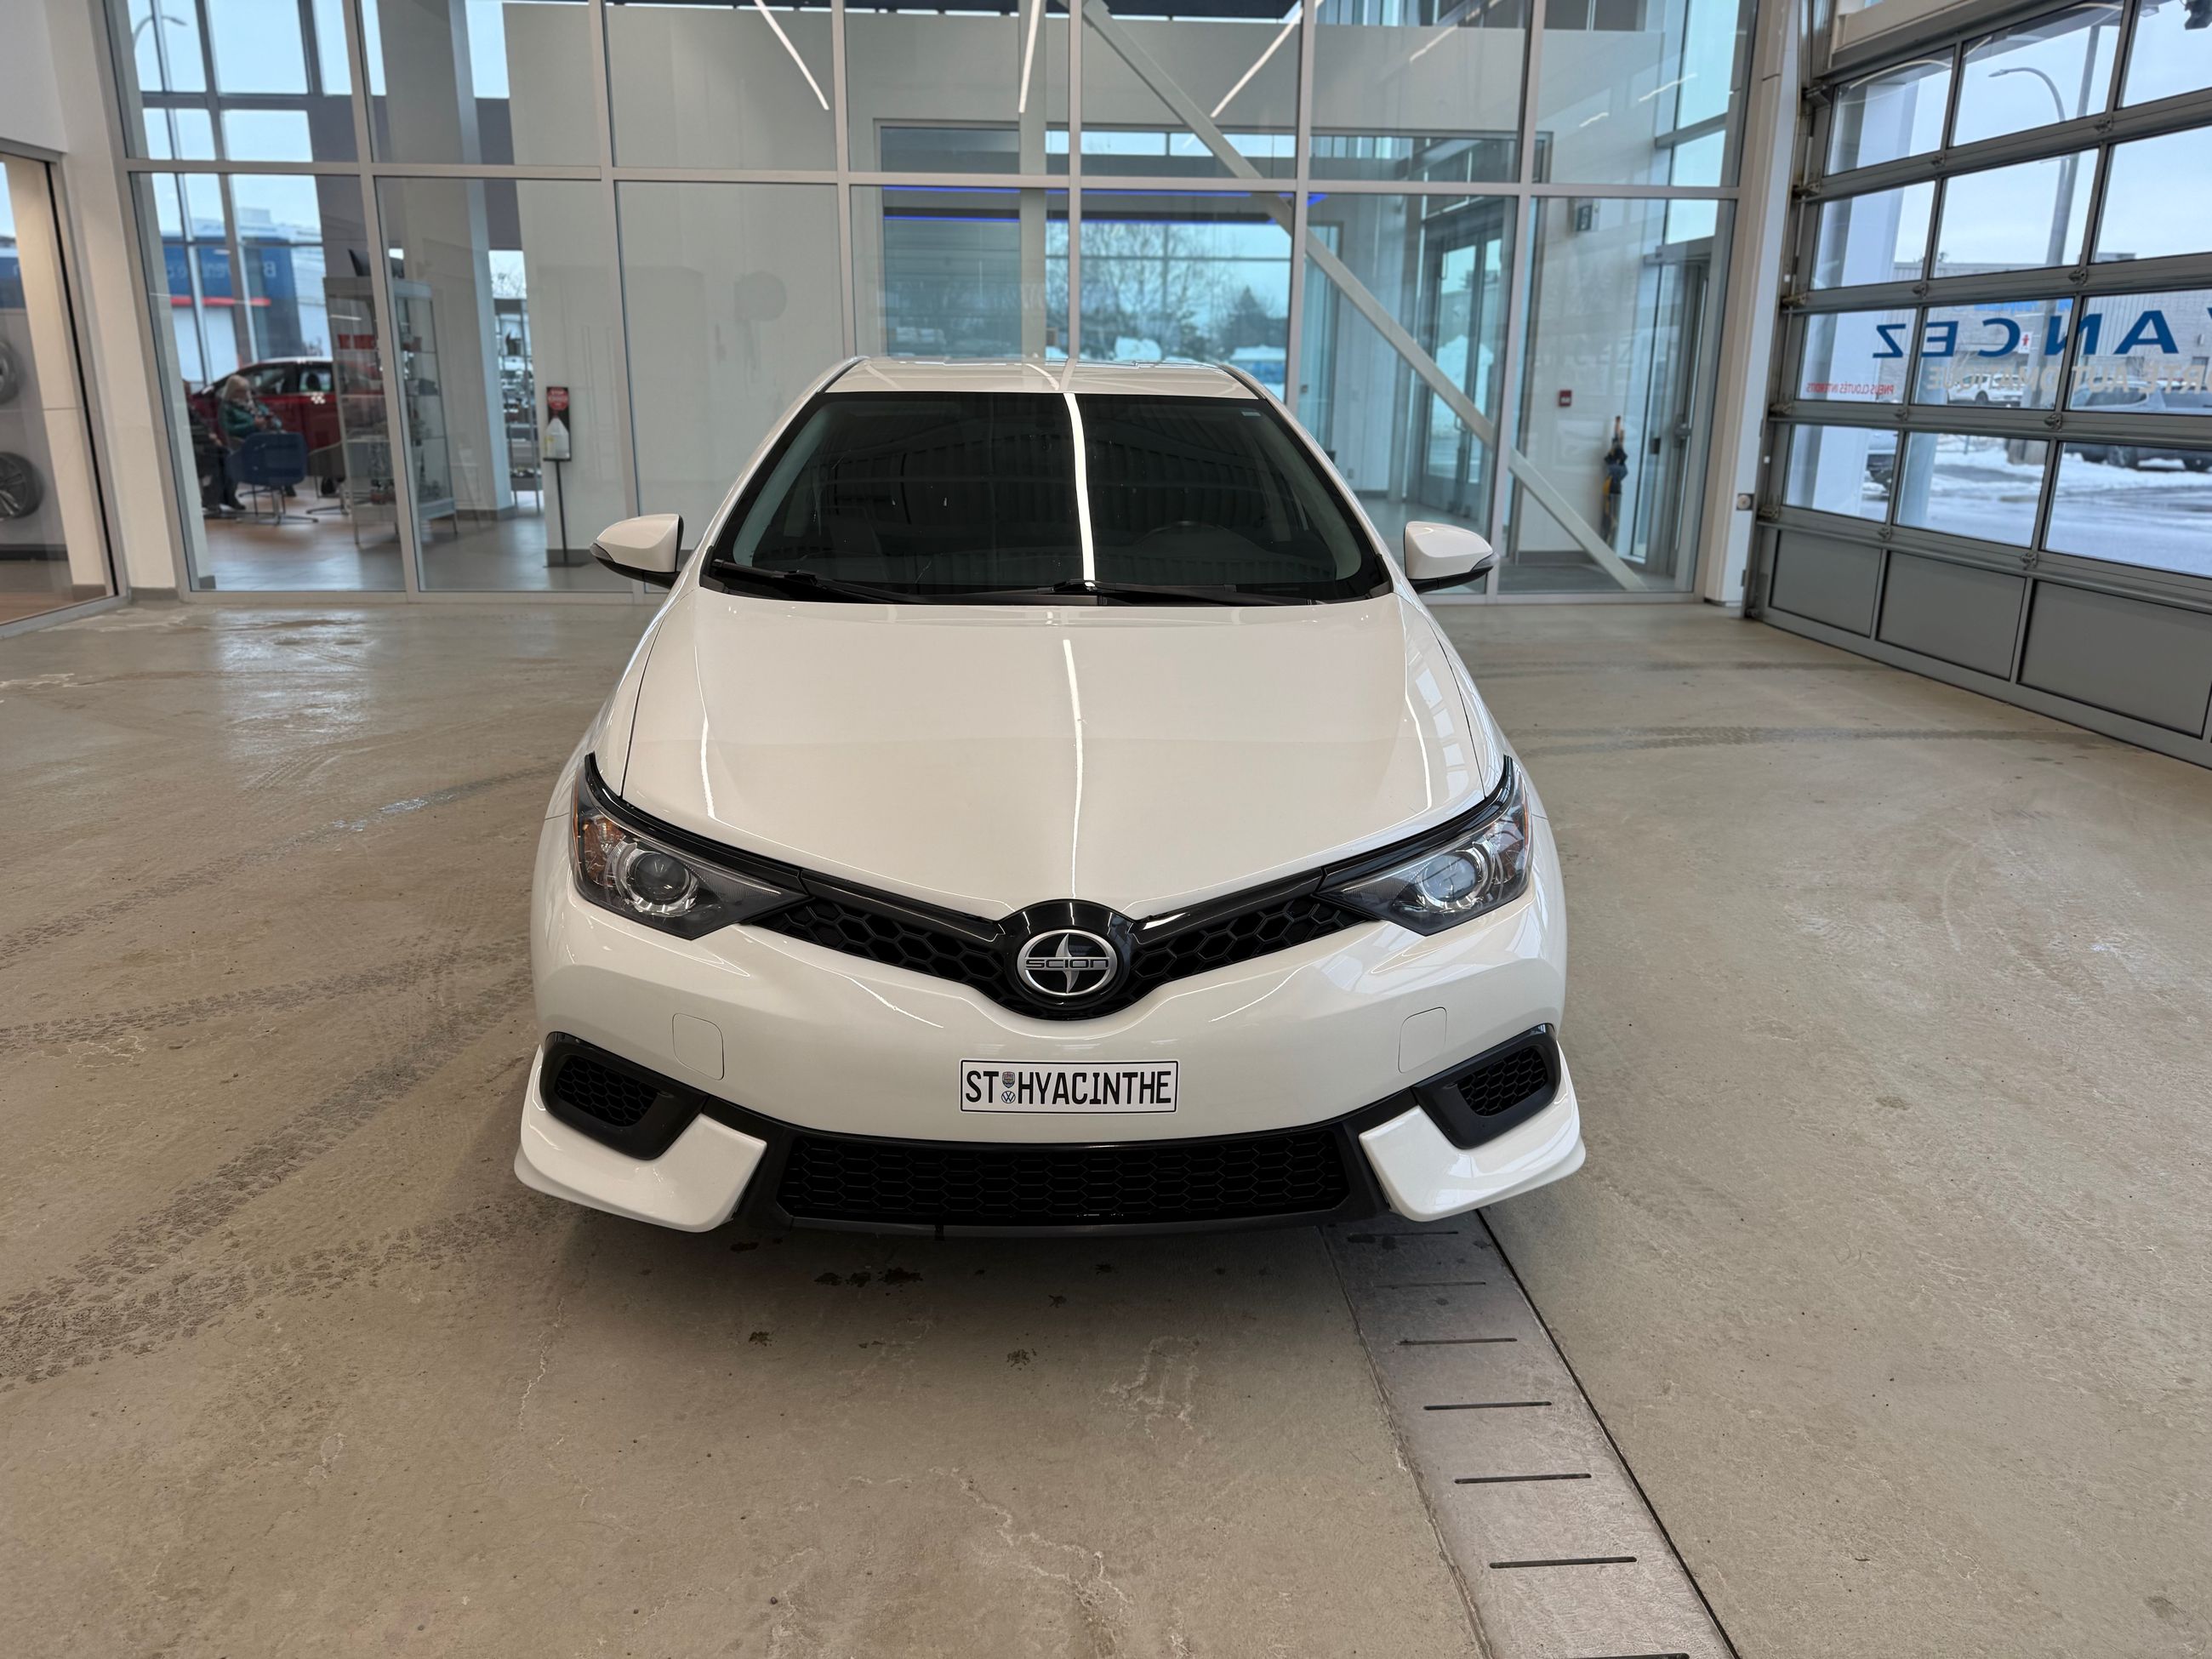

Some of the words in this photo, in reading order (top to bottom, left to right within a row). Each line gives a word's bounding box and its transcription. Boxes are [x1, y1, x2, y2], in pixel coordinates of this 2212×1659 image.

[1026, 959, 1109, 969] SCION
[966, 1070, 1000, 1103] ST
[1018, 1070, 1172, 1104] HYACINTHE
